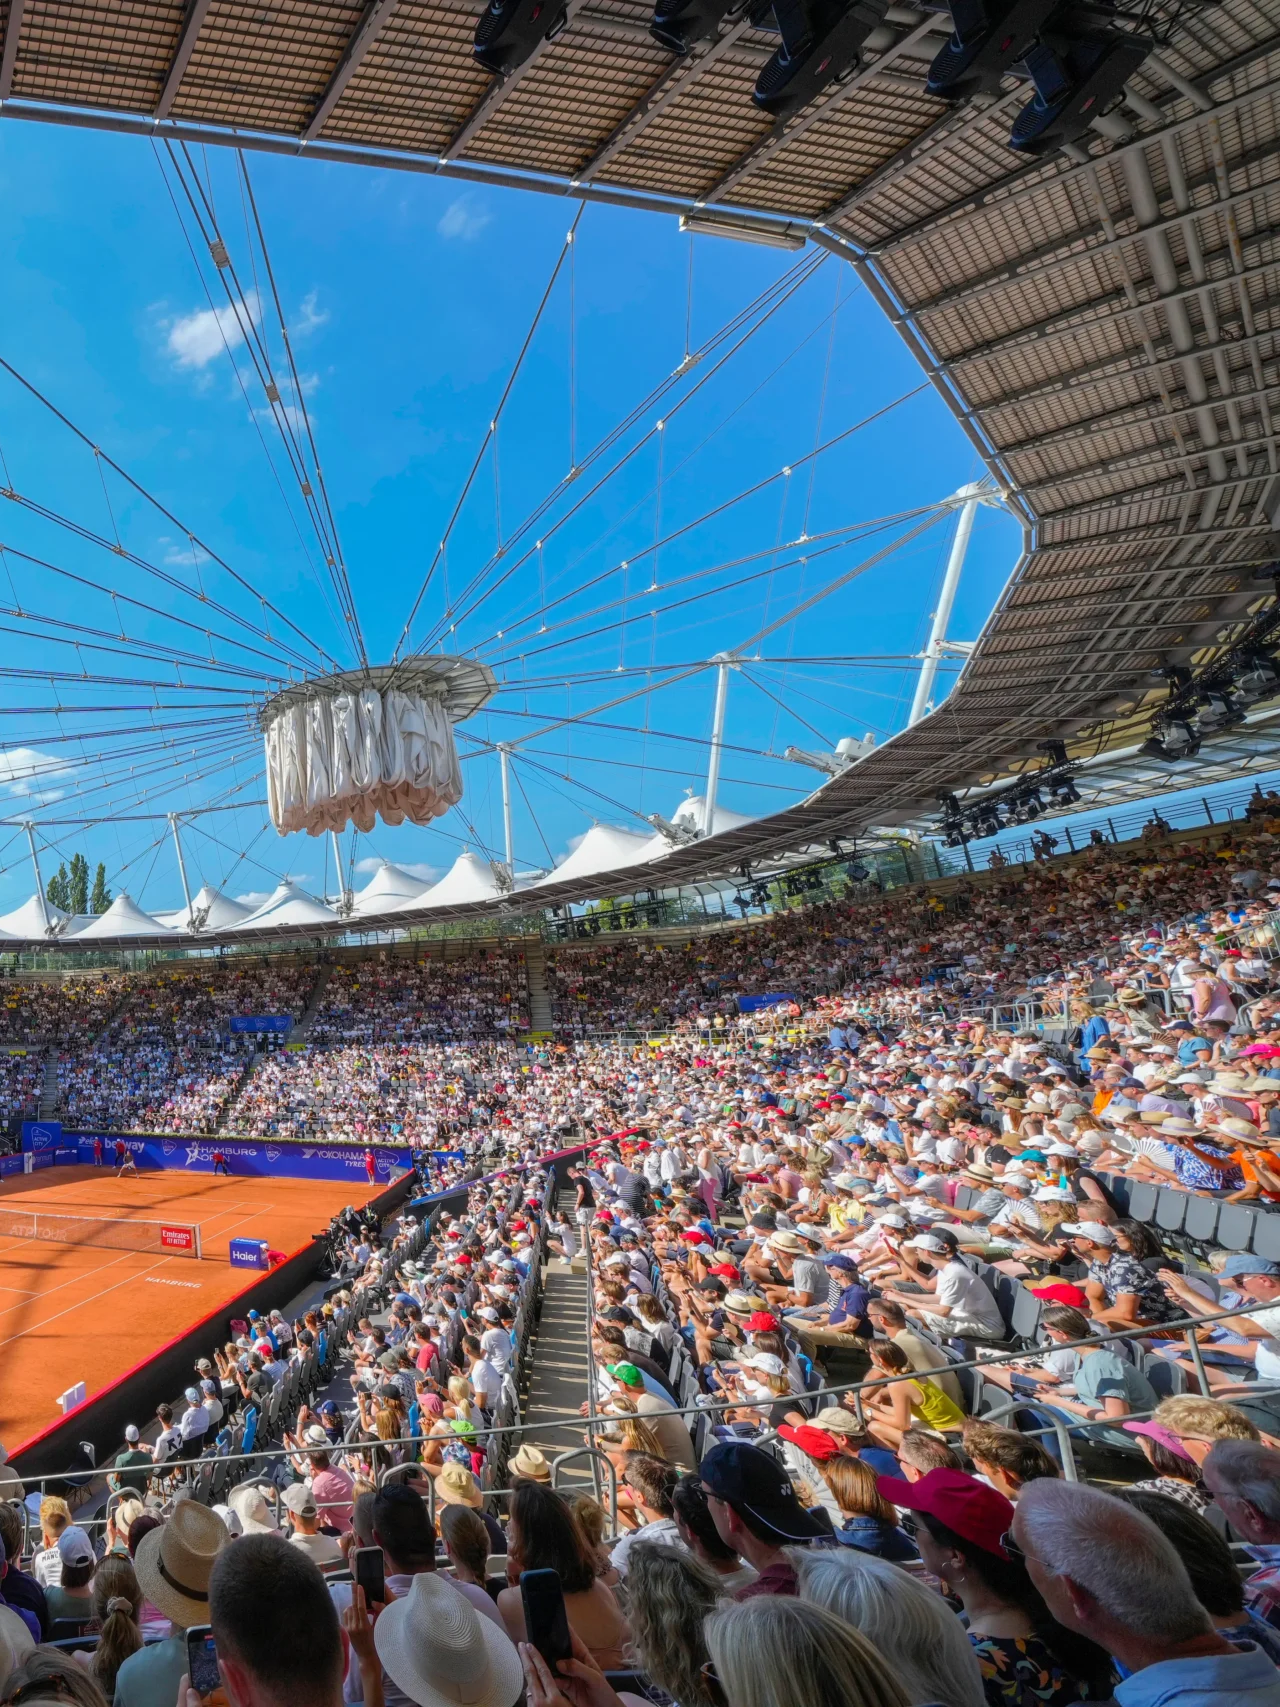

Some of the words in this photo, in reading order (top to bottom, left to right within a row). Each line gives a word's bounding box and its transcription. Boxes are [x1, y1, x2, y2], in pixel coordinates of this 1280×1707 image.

[104, 1138, 145, 1153] beway
[201, 1146, 257, 1156] HAMBURG
[201, 1154, 230, 1162] OPN
[316, 1150, 366, 1161] YOKOHAMA
[344, 1160, 366, 1168] TYRES
[162, 1229, 190, 1240] Emirates
[232, 1251, 257, 1262] Haier
[145, 1277, 204, 1289] HAMBURG
